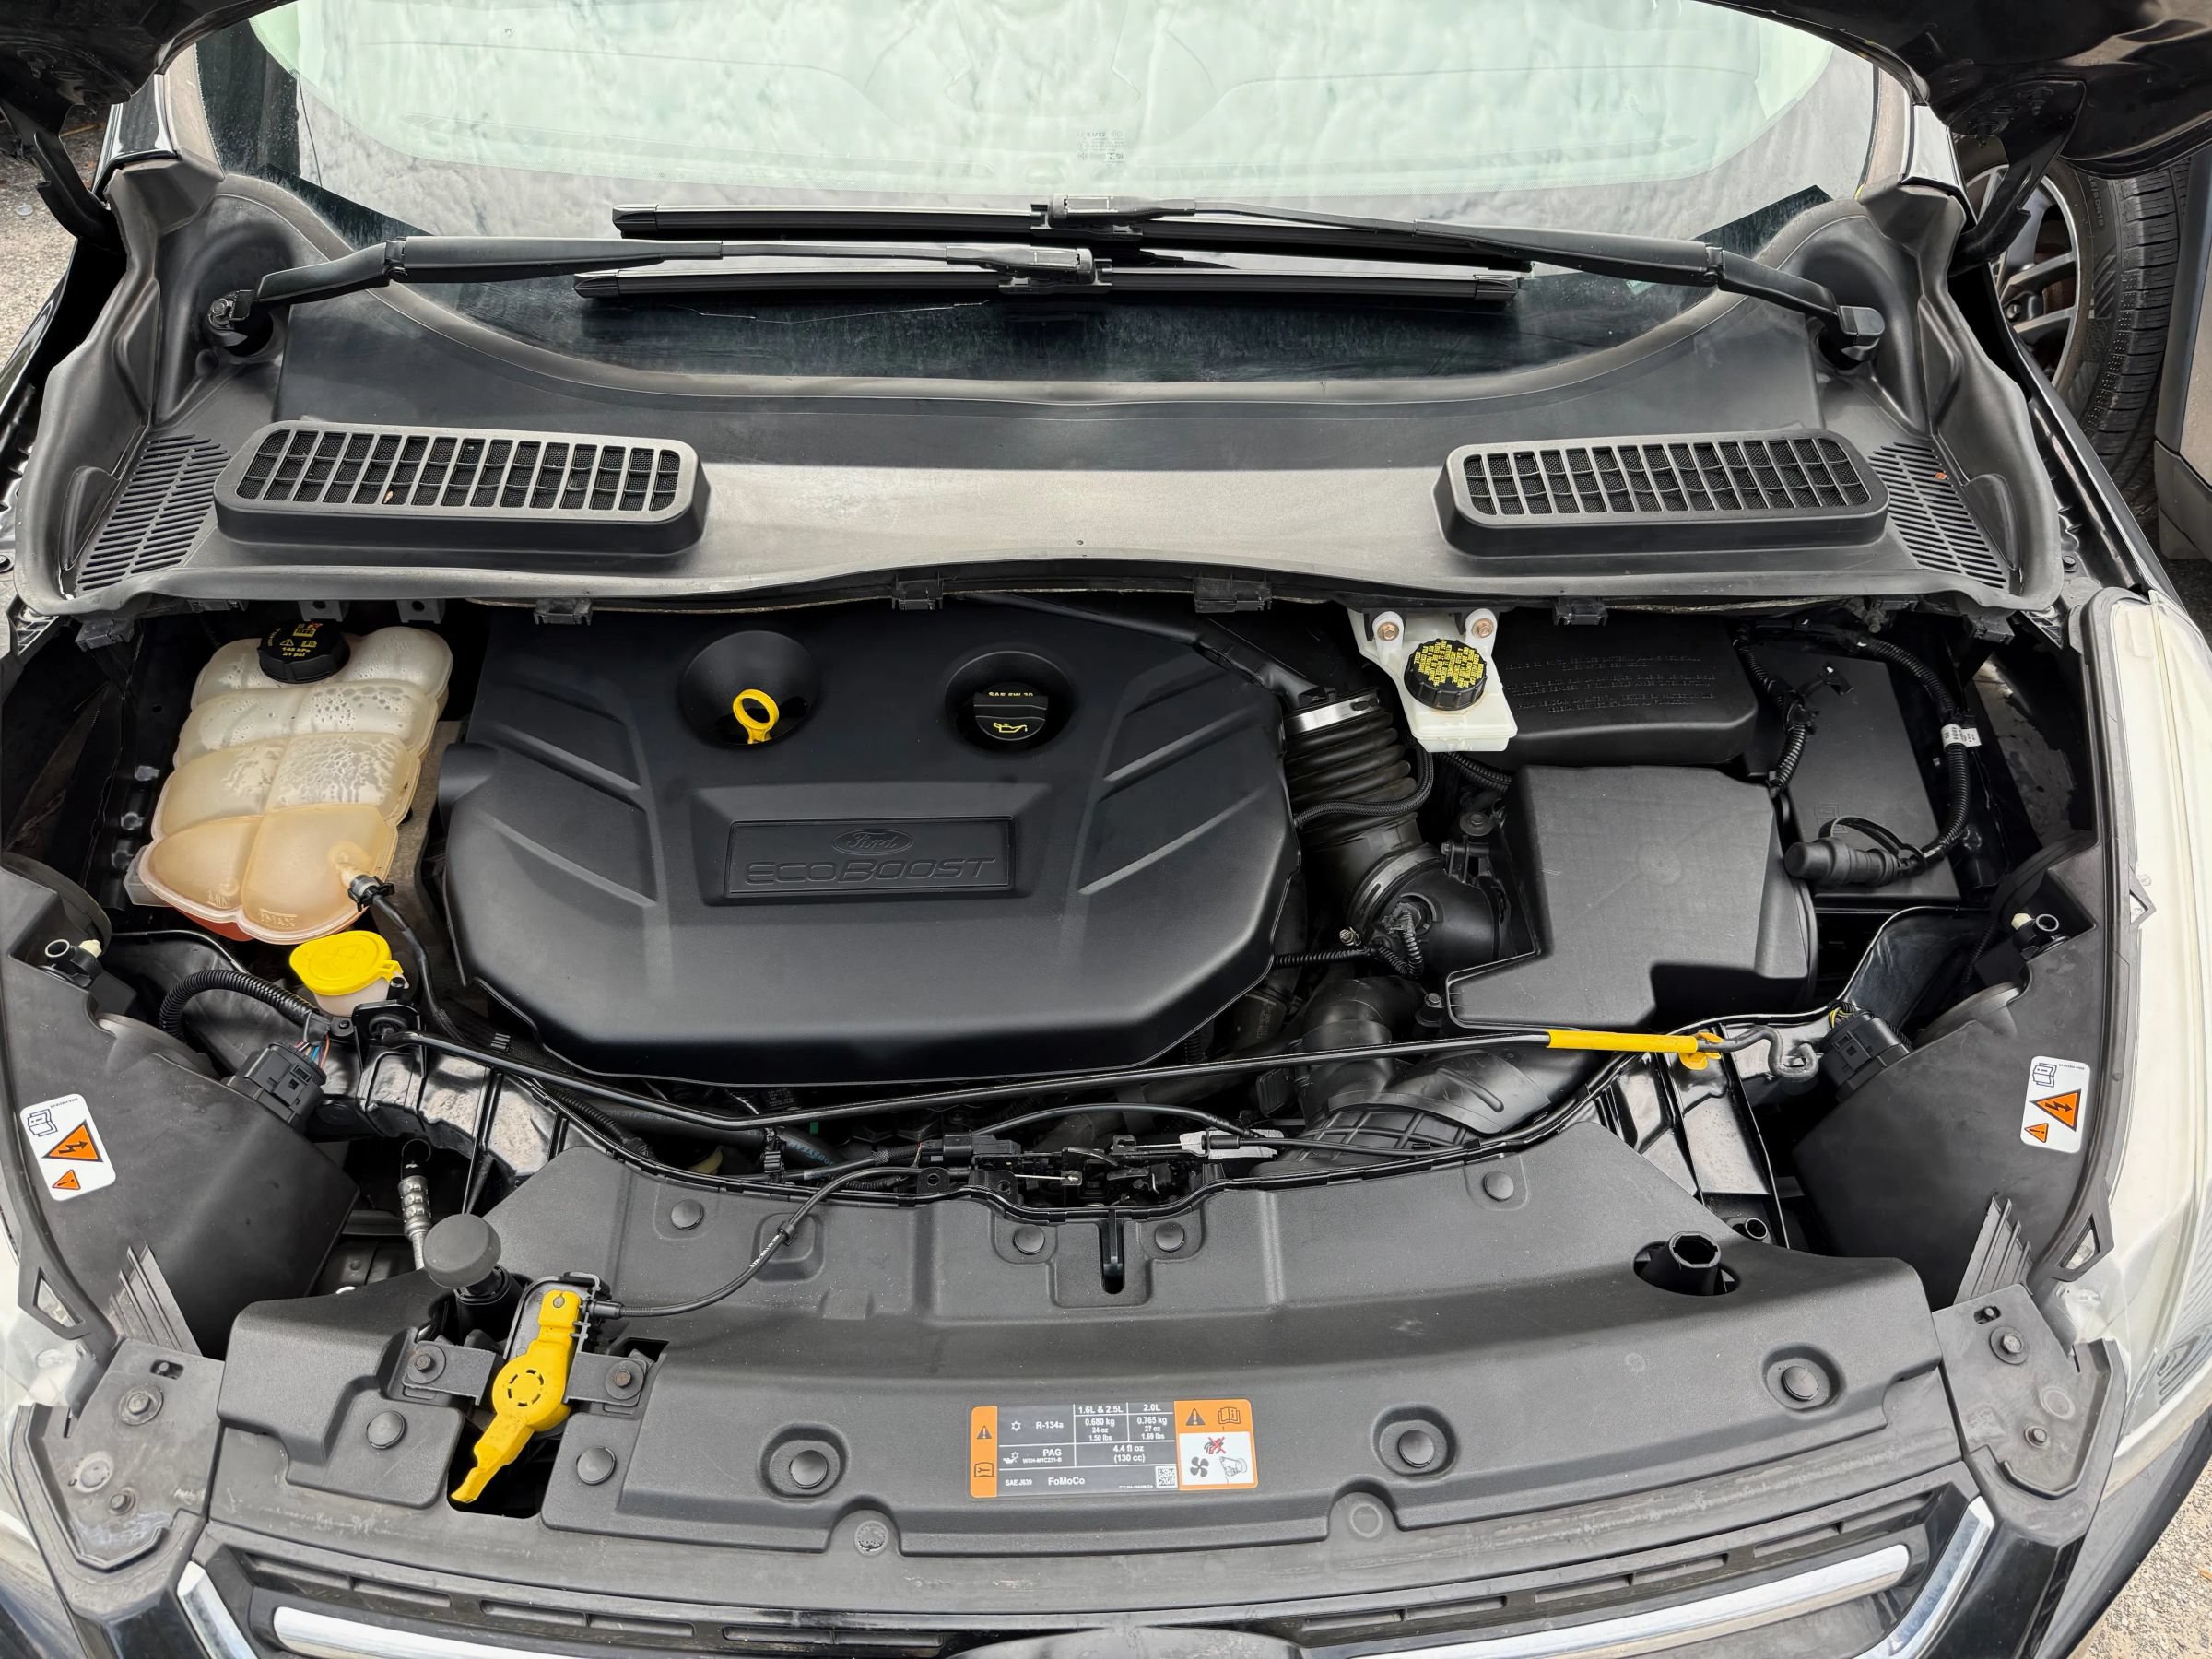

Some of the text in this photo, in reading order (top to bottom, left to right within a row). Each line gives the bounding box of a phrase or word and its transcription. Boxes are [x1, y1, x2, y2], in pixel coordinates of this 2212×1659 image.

[847, 831, 897, 850] Ford
[745, 857, 996, 886] ECOBOOST
[1078, 1405, 1124, 1414] 1.6L & 2.5L
[1143, 1403, 1161, 1412] 2.0L
[1035, 1420, 1064, 1430] R-134a
[1085, 1418, 1115, 1427] 0.680 kg
[1136, 1416, 1168, 1426] 0.765 kg
[1042, 1448, 1062, 1456] PAG
[1113, 1444, 1125, 1453] 4.4
[1126, 1444, 1133, 1453] fl
[1113, 1453, 1146, 1464] (130 cc)
[1048, 1477, 1085, 1486] FoMoCo
